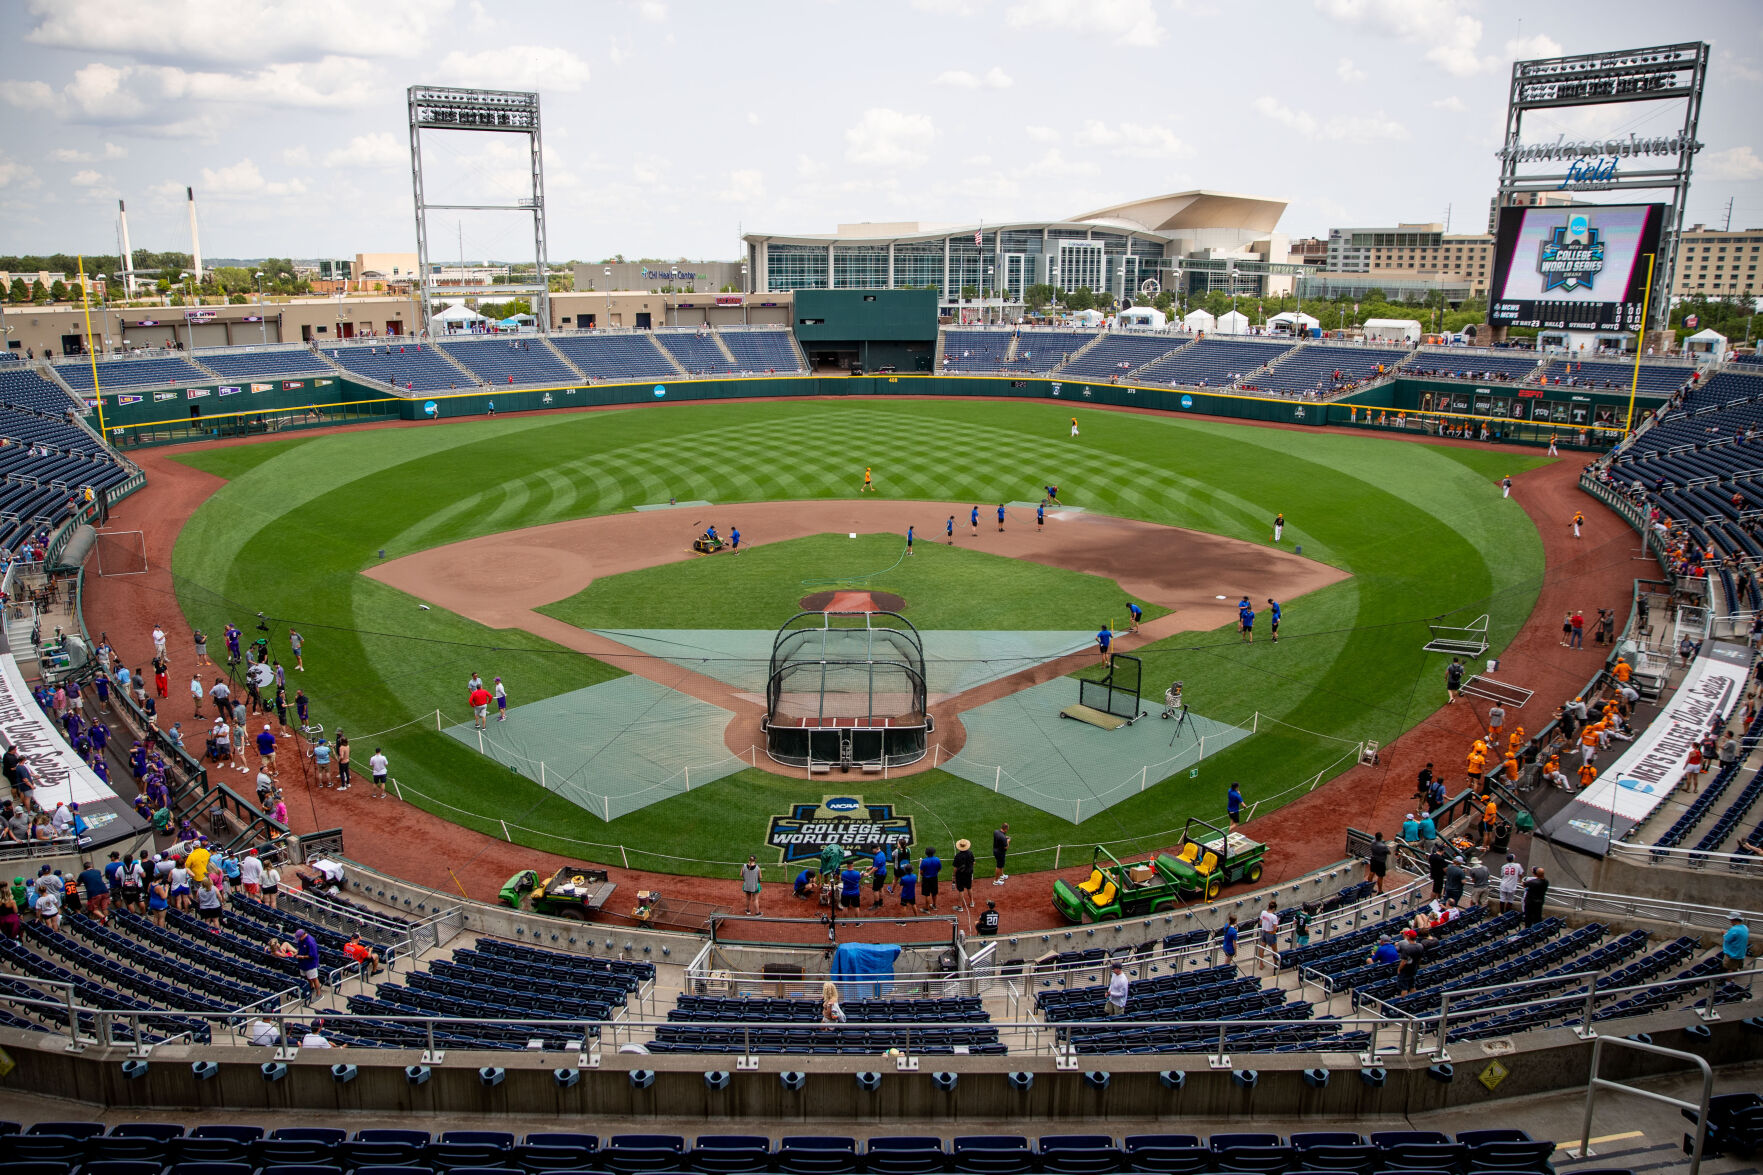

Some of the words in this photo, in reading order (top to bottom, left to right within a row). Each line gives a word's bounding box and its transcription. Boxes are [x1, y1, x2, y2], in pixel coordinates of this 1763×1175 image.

[1558, 157, 1618, 189] field
[1556, 250, 1593, 260] COLLEGE
[1541, 261, 1573, 272] WORLD
[1573, 261, 1602, 271] SERIES
[648, 271, 658, 280] CHI
[678, 271, 696, 280] Center
[1518, 389, 1543, 398] ESPN
[1438, 398, 1449, 410] F
[1573, 409, 1586, 421] T
[1688, 676, 1728, 700] Series
[1670, 696, 1716, 726] World
[4, 720, 53, 752] World
[1653, 724, 1702, 758] COLLEGE
[1627, 754, 1677, 784] MEN'S
[801, 824, 883, 834] COLLEGE
[773, 834, 841, 844] WORLD
[66, 886, 77, 895] 35
[987, 917, 998, 925] 20
